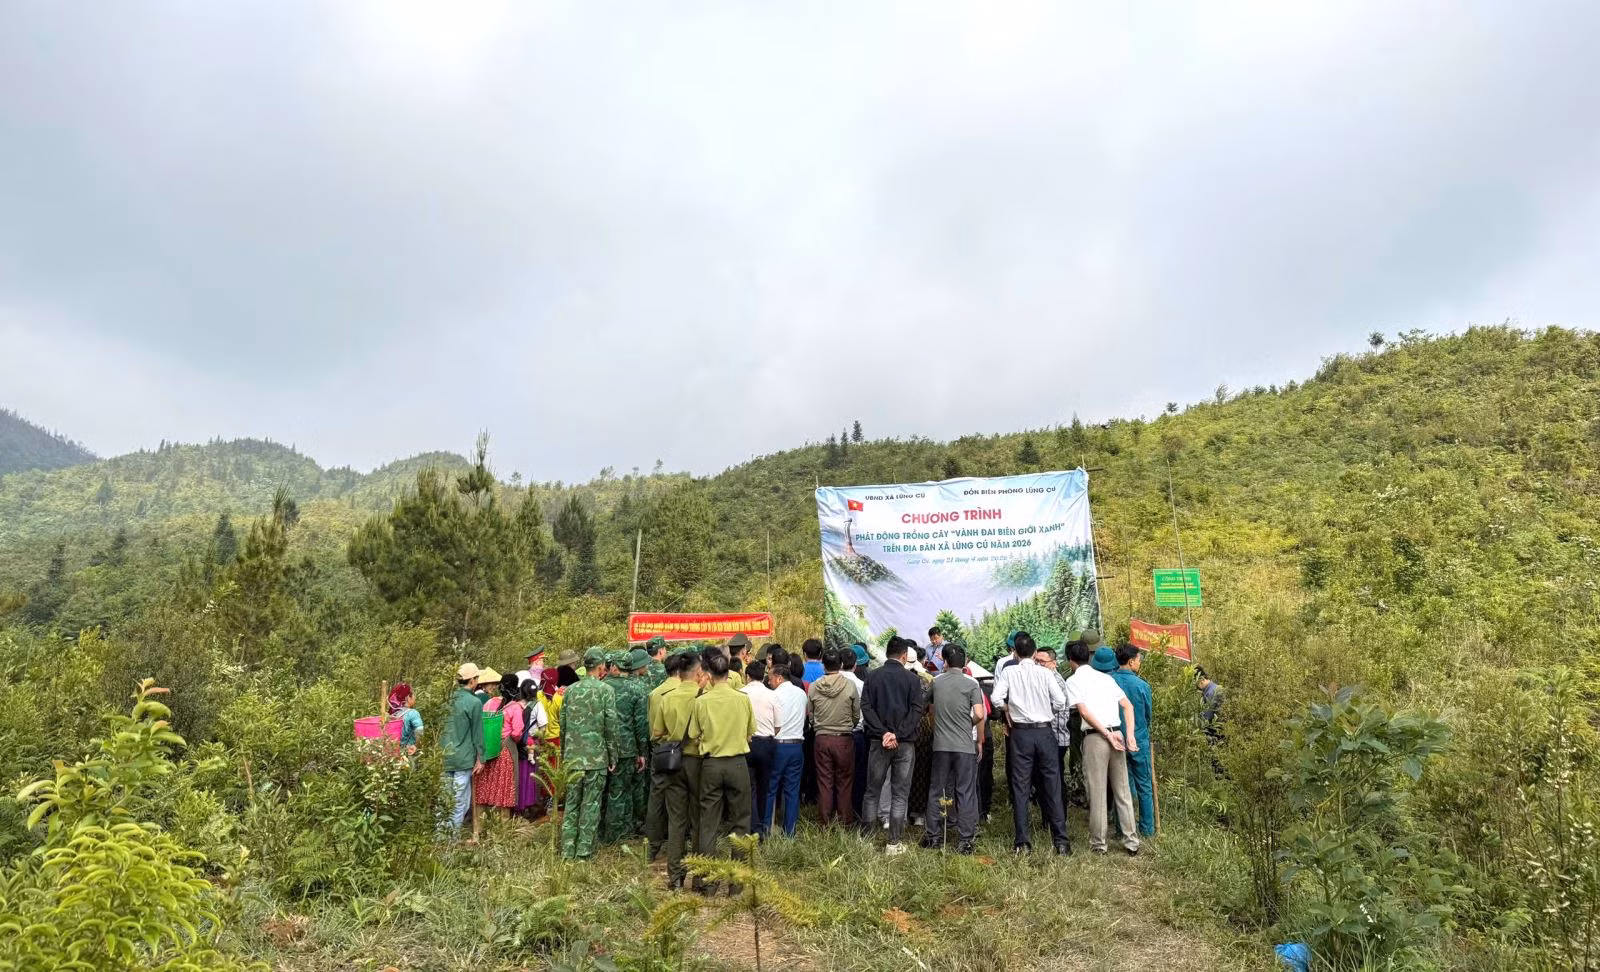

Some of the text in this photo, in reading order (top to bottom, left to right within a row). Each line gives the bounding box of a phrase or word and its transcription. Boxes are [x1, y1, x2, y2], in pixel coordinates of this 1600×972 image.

[902, 506, 1002, 524] CHƯƠNG TRÌNH
[856, 532, 874, 541] PHÁT
[876, 531, 900, 541] ĐỘNG
[903, 529, 930, 540] TRỒNG
[932, 530, 949, 538] CÂY
[981, 528, 996, 536] ĐAI
[998, 526, 1016, 536] BIÊN
[1018, 525, 1036, 535] GIỚI
[883, 539, 1032, 554] TRÊN ĐỊA BÀN XÃ LŨNG CÚ NĂM 2026
